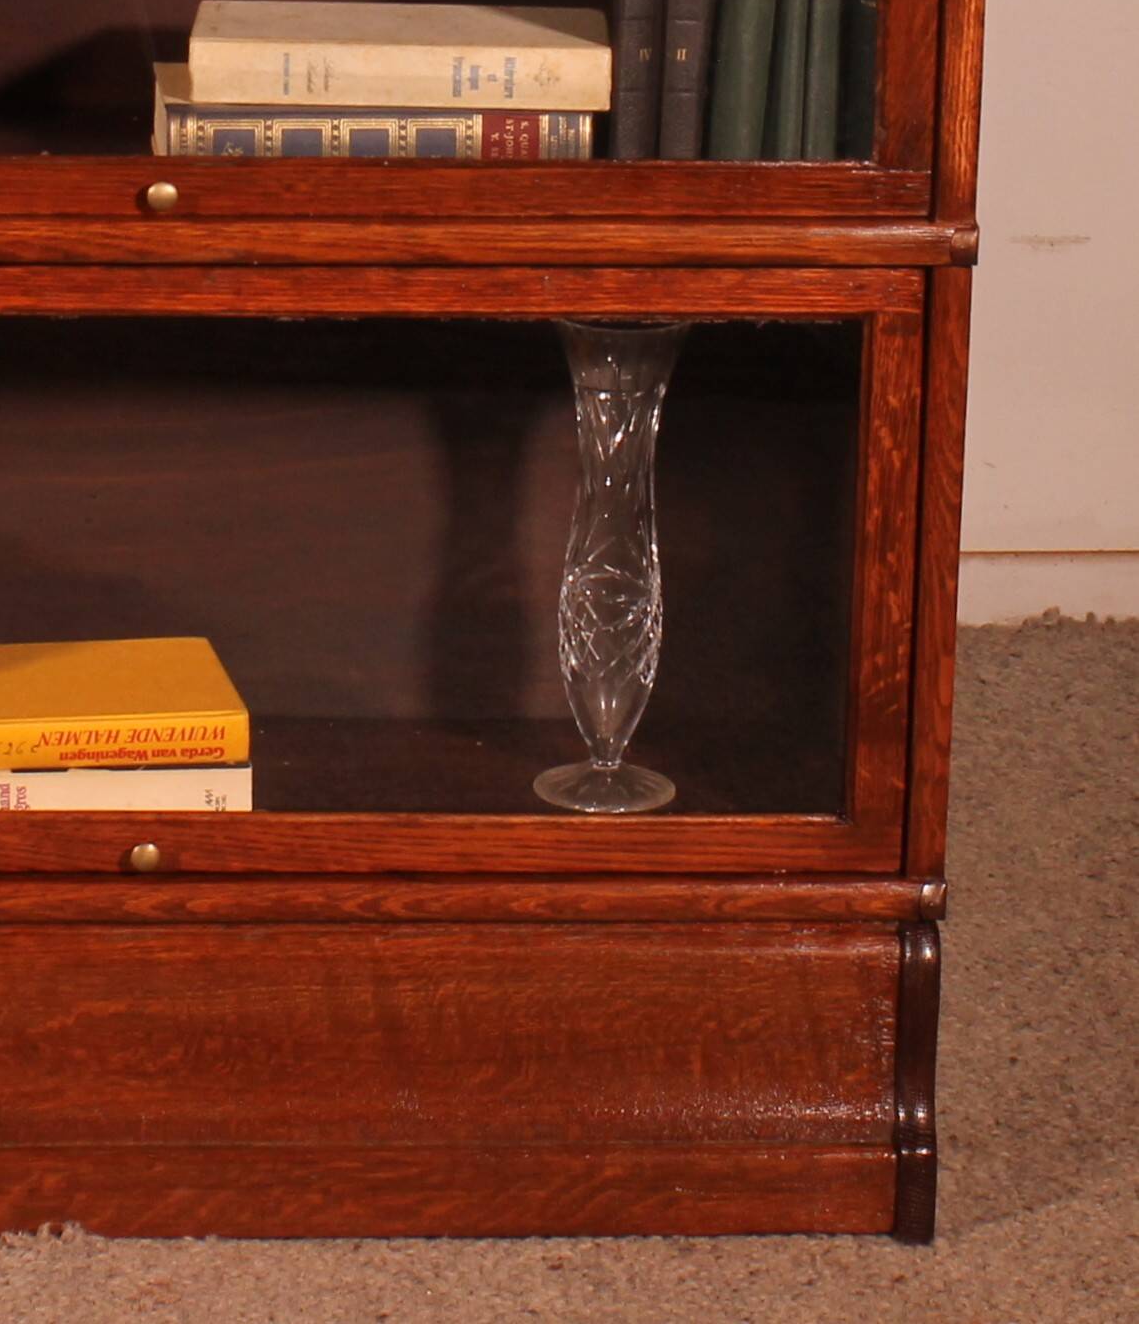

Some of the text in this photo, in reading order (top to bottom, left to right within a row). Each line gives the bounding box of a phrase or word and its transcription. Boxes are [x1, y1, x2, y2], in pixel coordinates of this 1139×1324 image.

[37, 725, 226, 747] WUIVENDE HALMEN
[58, 746, 225, 762] Gerda van Wageningen
